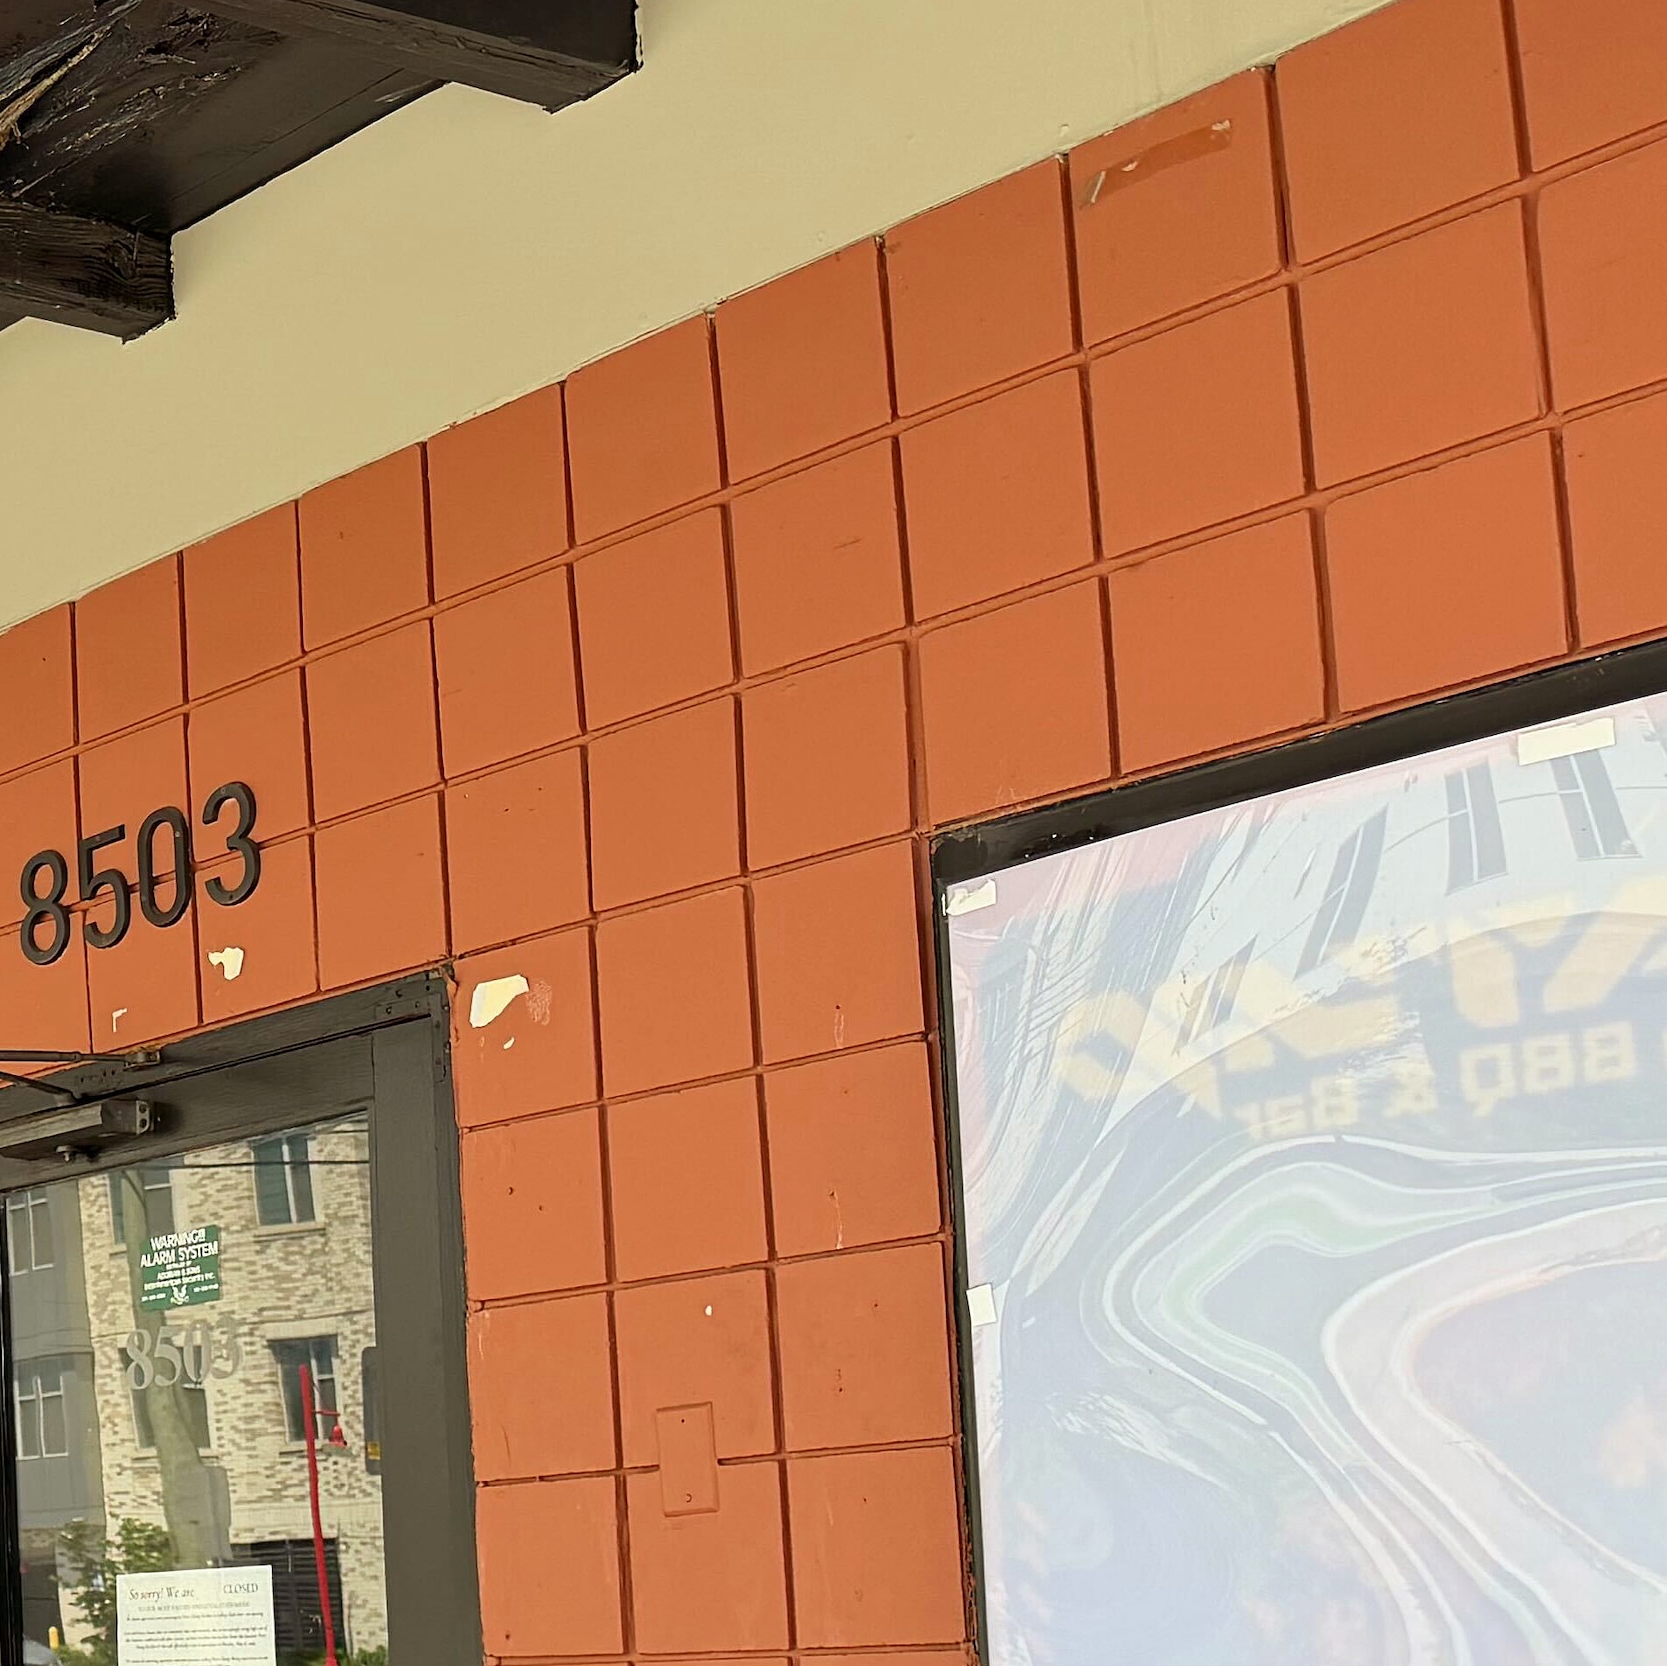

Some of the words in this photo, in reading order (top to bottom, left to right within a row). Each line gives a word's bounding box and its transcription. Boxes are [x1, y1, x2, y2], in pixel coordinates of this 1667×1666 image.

[20, 781, 261, 966] 8503
[140, 1249, 176, 1268] ALARM
[178, 1241, 219, 1261] SYSTEM
[126, 1314, 242, 1390] 8503
[129, 1588, 139, 1600] So
[140, 1587, 164, 1603] sorry!
[166, 1585, 179, 1598] We
[181, 1588, 195, 1598] are
[223, 1582, 259, 1595] CLOSED
